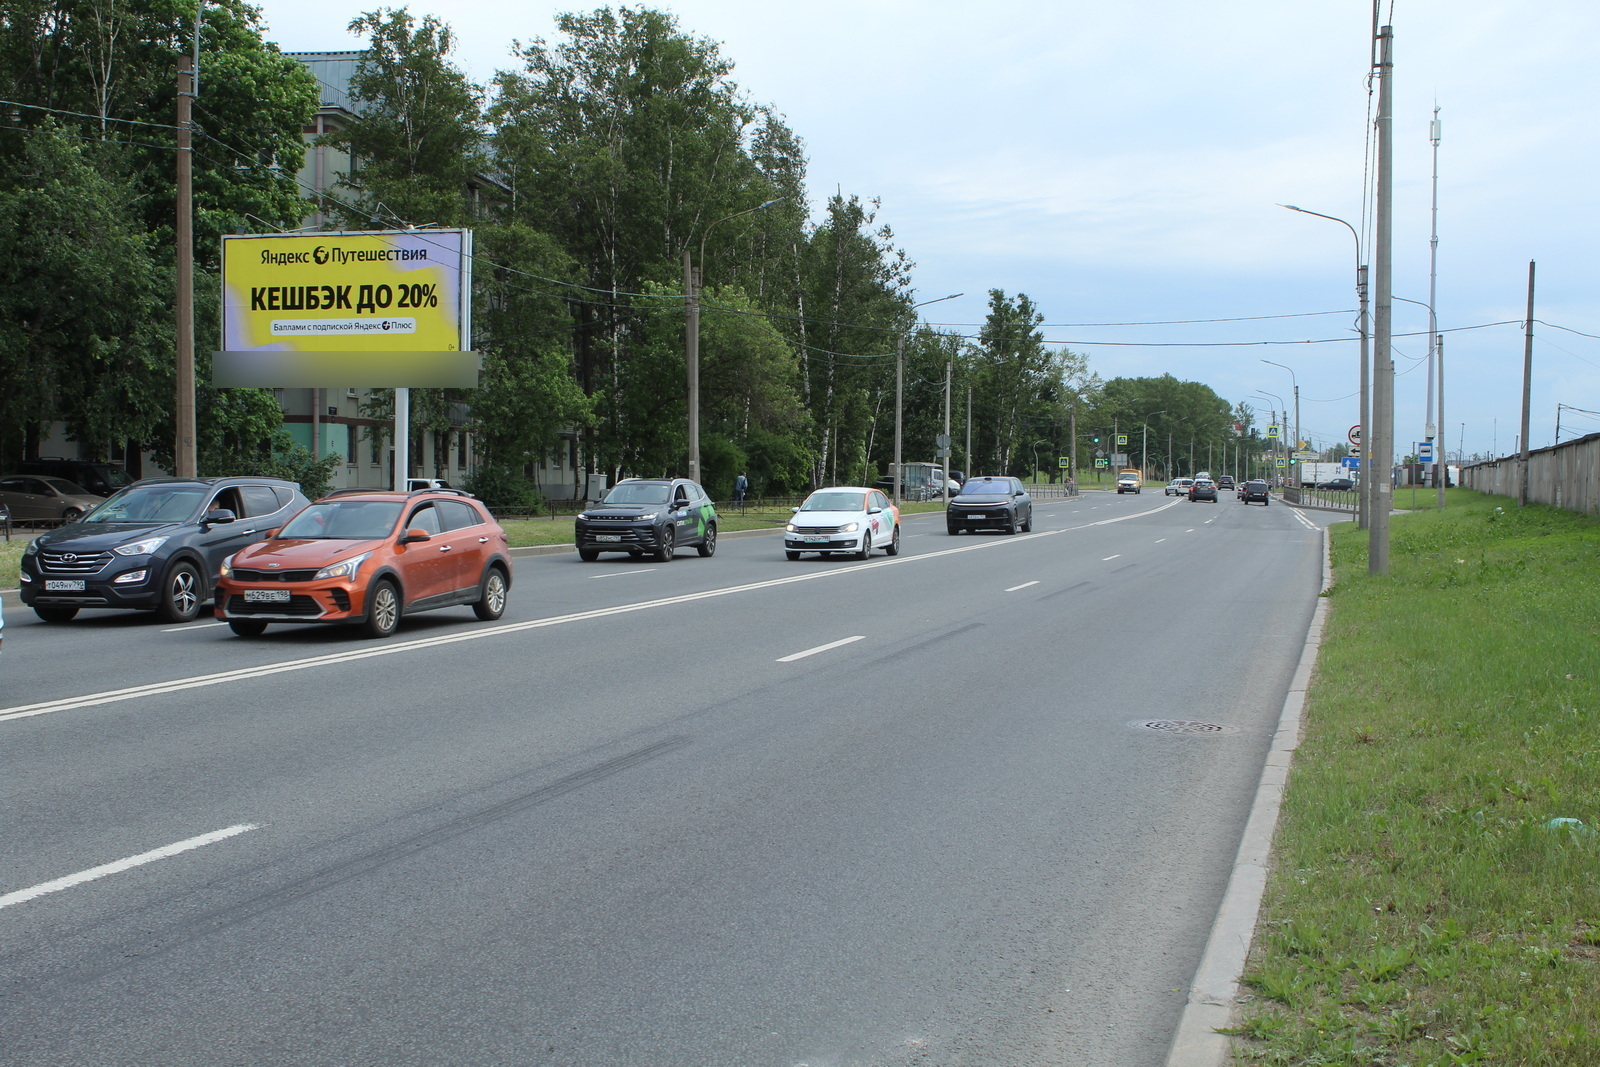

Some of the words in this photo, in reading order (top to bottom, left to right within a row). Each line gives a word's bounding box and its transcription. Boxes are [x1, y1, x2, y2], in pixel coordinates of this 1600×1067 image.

[261, 249, 310, 266] Яндекс
[331, 247, 427, 263] Путешествия
[251, 285, 352, 311] КЕШБЭК
[356, 284, 393, 314] ДО
[397, 283, 438, 309] 20%
[273, 322, 307, 332] Баллами
[313, 322, 353, 333] подпиской
[354, 322, 381, 332] Яндекс
[391, 321, 413, 330] Плюс
